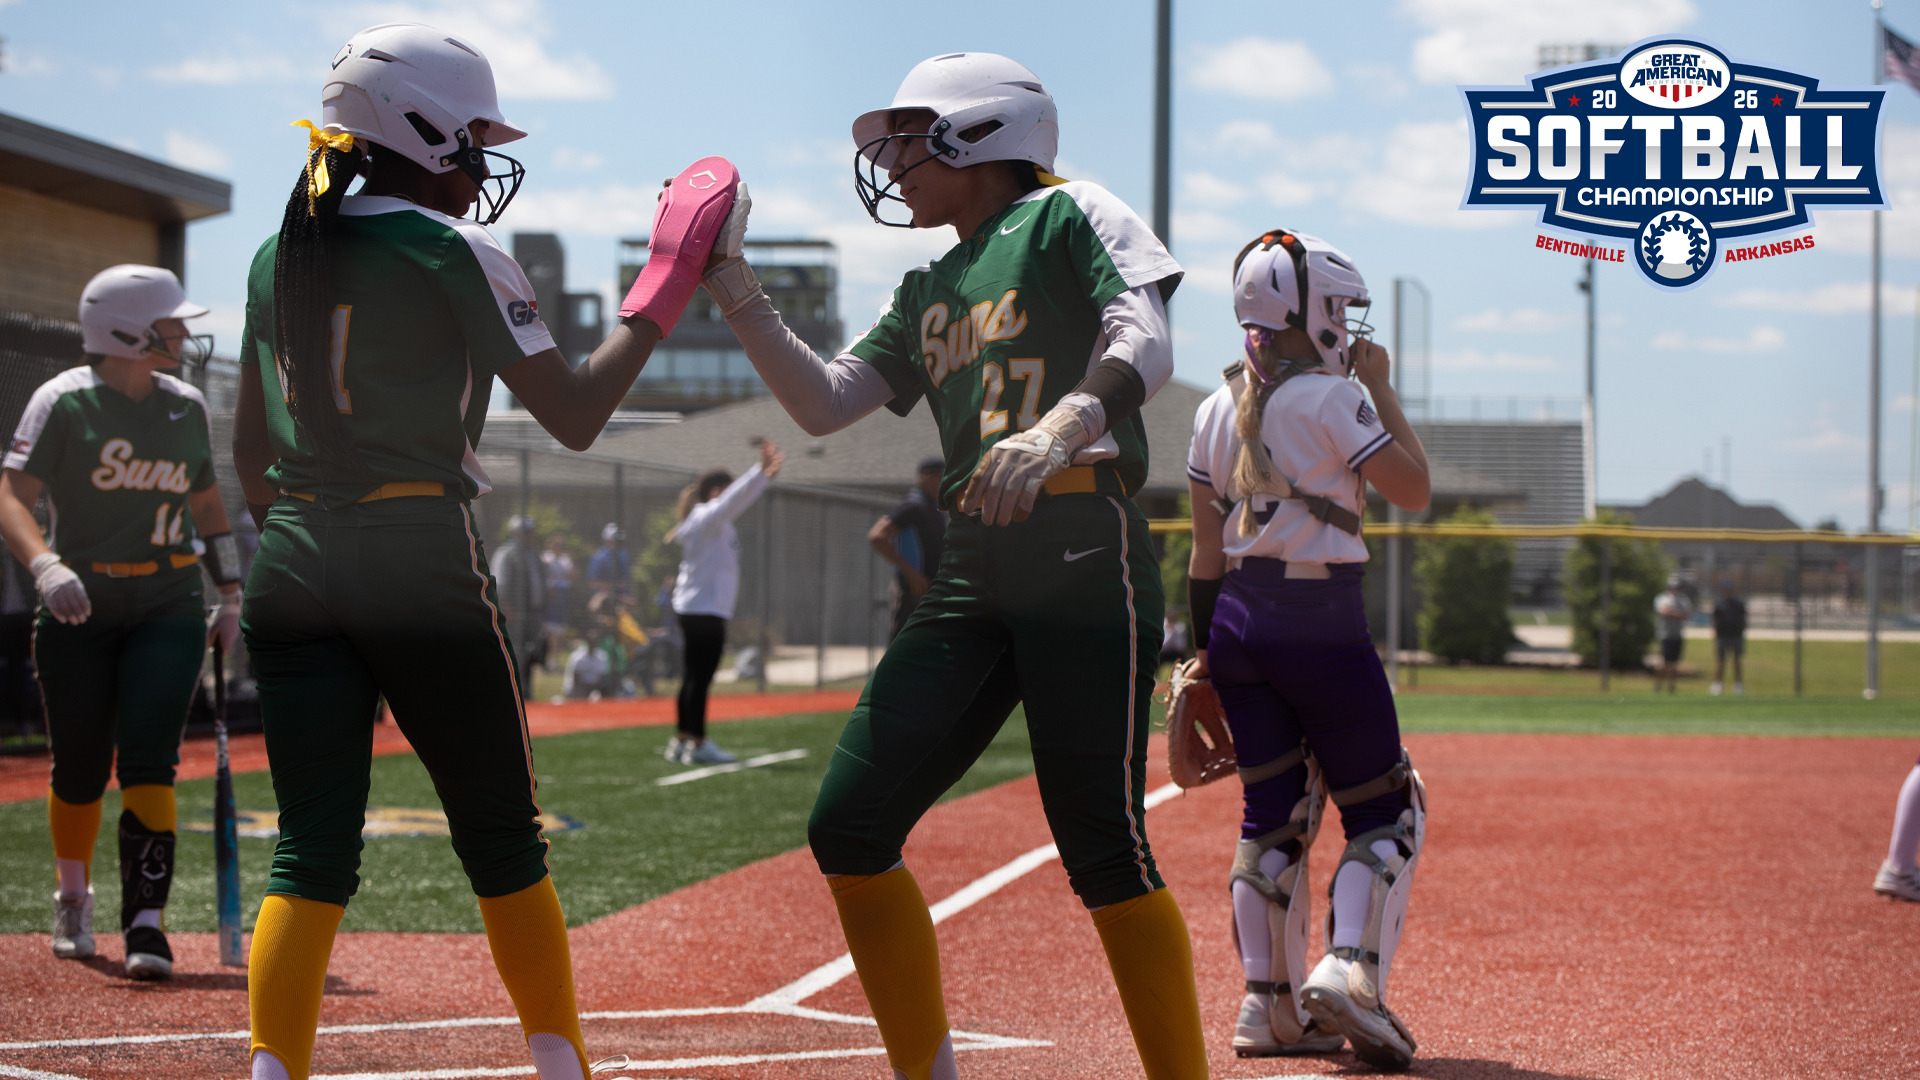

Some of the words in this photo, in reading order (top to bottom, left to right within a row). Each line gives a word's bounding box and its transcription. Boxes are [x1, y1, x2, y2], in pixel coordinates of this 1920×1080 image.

[921, 289, 1028, 389] Suns
[980, 358, 1045, 440] 27
[91, 438, 191, 494] Suns
